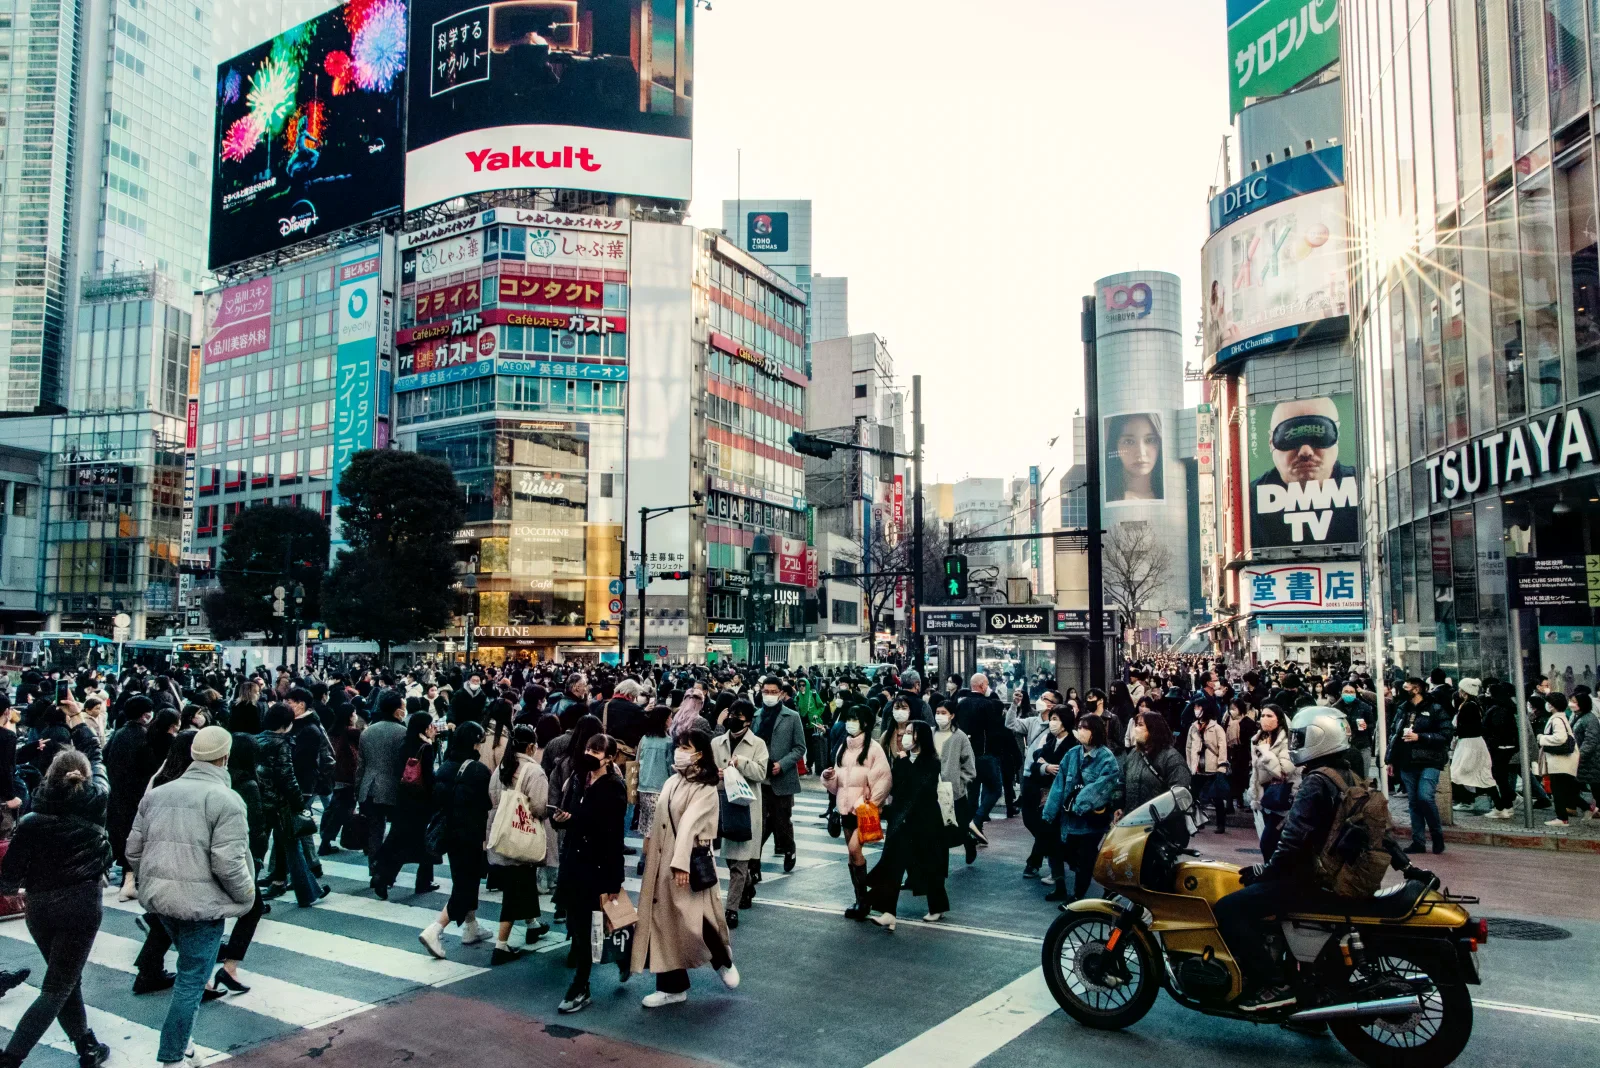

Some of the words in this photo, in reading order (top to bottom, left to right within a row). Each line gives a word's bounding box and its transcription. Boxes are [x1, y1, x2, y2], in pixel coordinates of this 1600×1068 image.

[438, 20, 482, 52] 科学する
[438, 48, 481, 78] ヤクルト
[465, 146, 602, 173] Yakult
[1223, 176, 1267, 216] DHC
[278, 210, 319, 237] Disney+
[408, 216, 477, 245] しゃぶしゃぶバイキング
[516, 210, 623, 231] しゃぶしゃぶバイキング
[440, 238, 478, 265] しゃぶ葉
[562, 236, 624, 259] しゃぶ葉
[343, 260, 375, 279] 当ビル5F
[404, 260, 416, 274] 9F
[234, 284, 269, 304] 品川スキン
[417, 283, 480, 315] プライス
[500, 278, 600, 302] コンタクト
[233, 300, 265, 317] クリニック
[1102, 283, 1153, 320] 109
[342, 318, 372, 335] eyecity
[451, 314, 483, 336] ガスト
[568, 314, 615, 334] ガスト
[1105, 312, 1136, 323] SHIBUYA
[213, 328, 267, 356] 品川美容外科
[1231, 345, 1244, 355] DHC
[1245, 334, 1274, 350] Channel
[400, 355, 414, 370] 7F
[435, 341, 474, 368] ガスト
[421, 366, 477, 386] 英会話イーオン
[501, 361, 531, 372] AEON
[539, 363, 626, 378] 英会話イーオン
[59, 451, 102, 463] MARK
[109, 450, 145, 459] CITY
[1425, 407, 1593, 504] TSUTAYA
[1257, 476, 1358, 514] DMM
[514, 527, 569, 536] L'OCCITANE
[1283, 510, 1333, 542] TV
[784, 556, 801, 570] アコム
[530, 580, 552, 590] Café
[1253, 571, 1355, 600] 堂書店
[774, 589, 799, 606] LUSH
[719, 624, 744, 633] サンドラッグ
[1008, 614, 1043, 623] しぶちか
[460, 627, 530, 637] L'CCITANE
